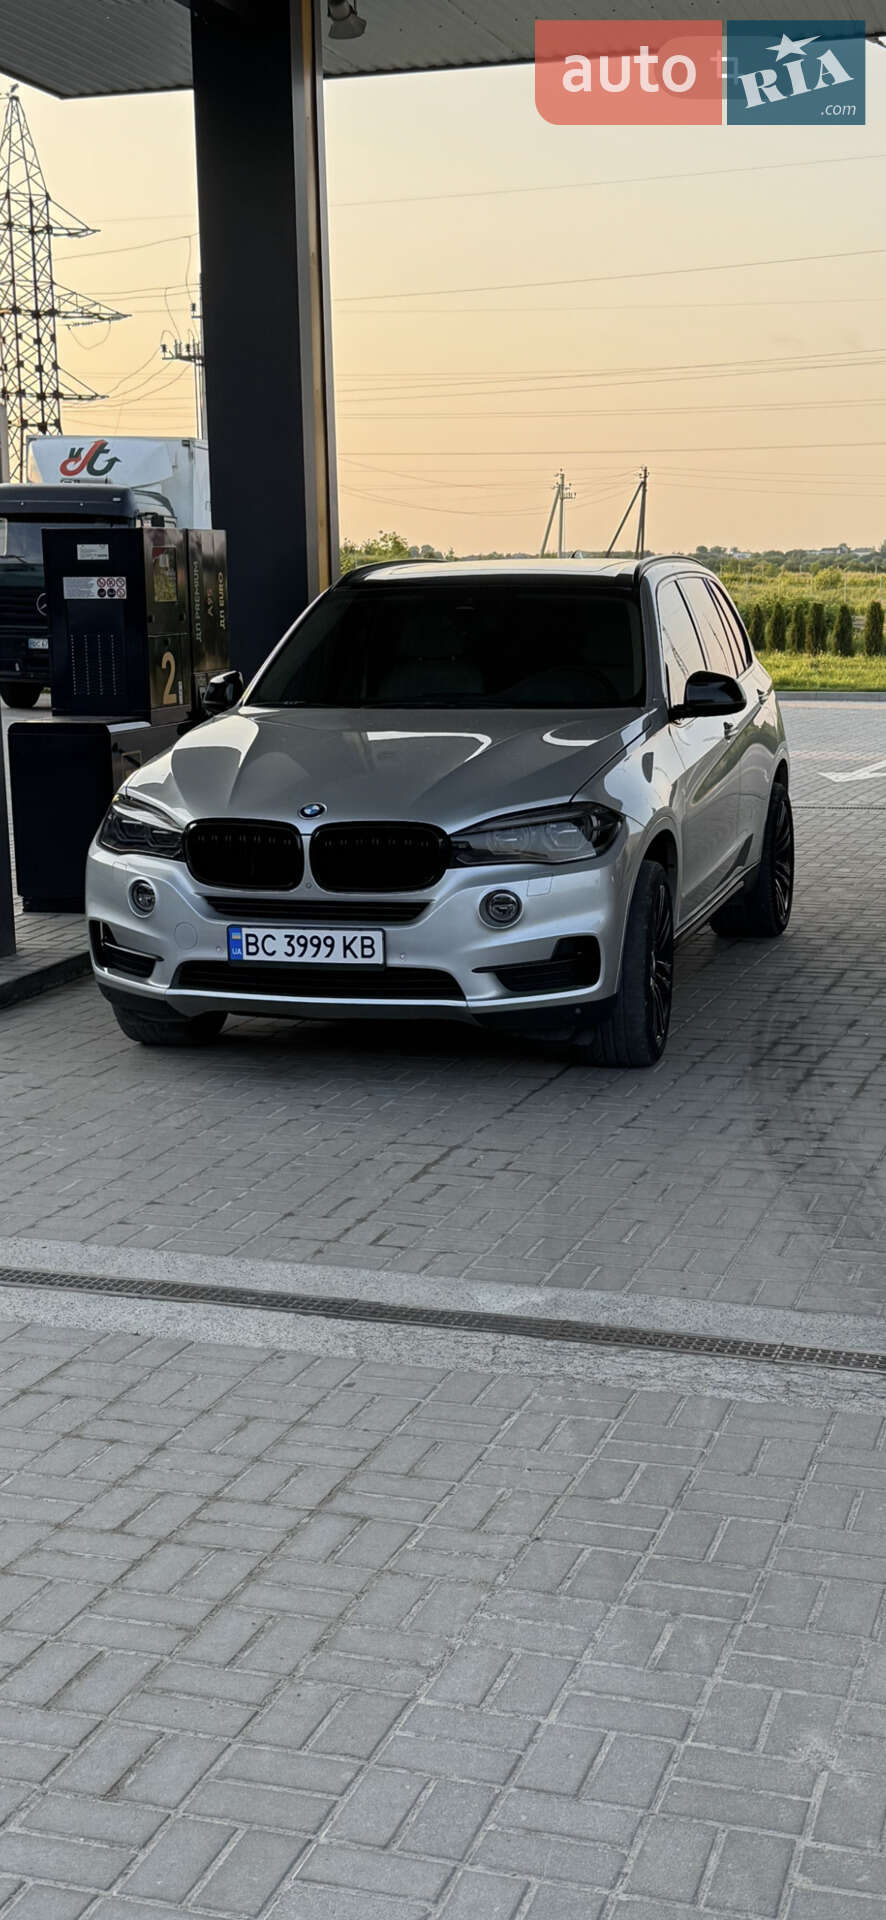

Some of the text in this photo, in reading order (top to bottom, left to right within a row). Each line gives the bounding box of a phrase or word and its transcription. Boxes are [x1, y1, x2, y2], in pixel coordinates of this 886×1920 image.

[192, 560, 201, 619] PREMIUM
[217, 571, 225, 607] EURO
[161, 651, 177, 705] 2
[231, 947, 242, 955] UA
[245, 933, 376, 959] BC 3999 KB
